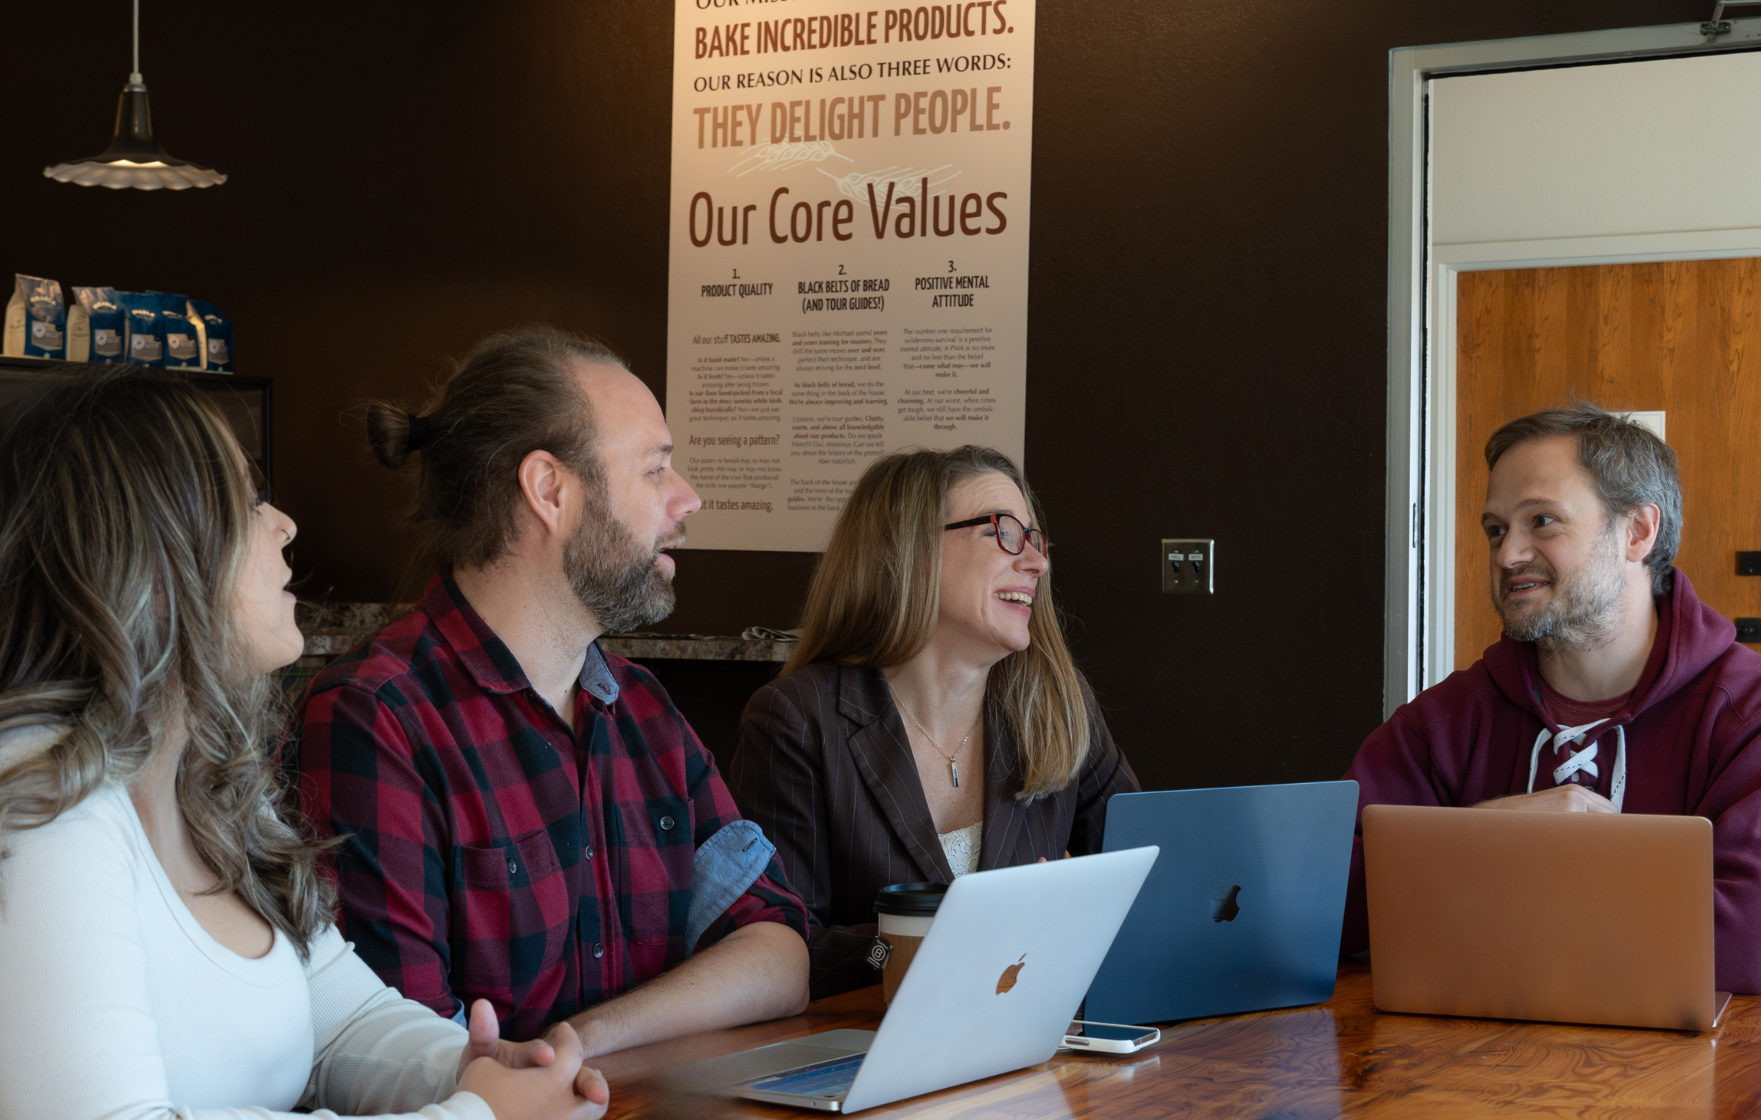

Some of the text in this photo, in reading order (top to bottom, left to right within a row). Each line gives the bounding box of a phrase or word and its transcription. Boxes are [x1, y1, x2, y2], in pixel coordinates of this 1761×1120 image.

[695, 0, 1014, 59] BAKE INCREDIBLE PRODUCTS.
[694, 53, 1012, 92] OUR REASON IS ALSO THREE WORDS:
[693, 86, 1011, 149] THEY DELIGHT PEOPLE.
[689, 177, 1008, 247] Our Core Values
[733, 269, 741, 279] 1.
[839, 265, 847, 275] 2.
[949, 261, 957, 273] 3.
[702, 283, 772, 297] PRODUCT QUALITY
[798, 279, 890, 294] BLACK BELTS OF BREAD
[916, 276, 988, 290] POSITIVE MENTAL
[803, 296, 884, 313] (AND TOUR GUIDES!)
[933, 294, 973, 308] ATTITUDE
[714, 334, 728, 344] stuff
[730, 334, 751, 344] TASTES
[752, 334, 781, 343] AMAZING.
[689, 435, 780, 447] Are you seeing a pattern?
[709, 499, 714, 509] it
[716, 499, 739, 510] tastes
[740, 500, 773, 513] amazing.
